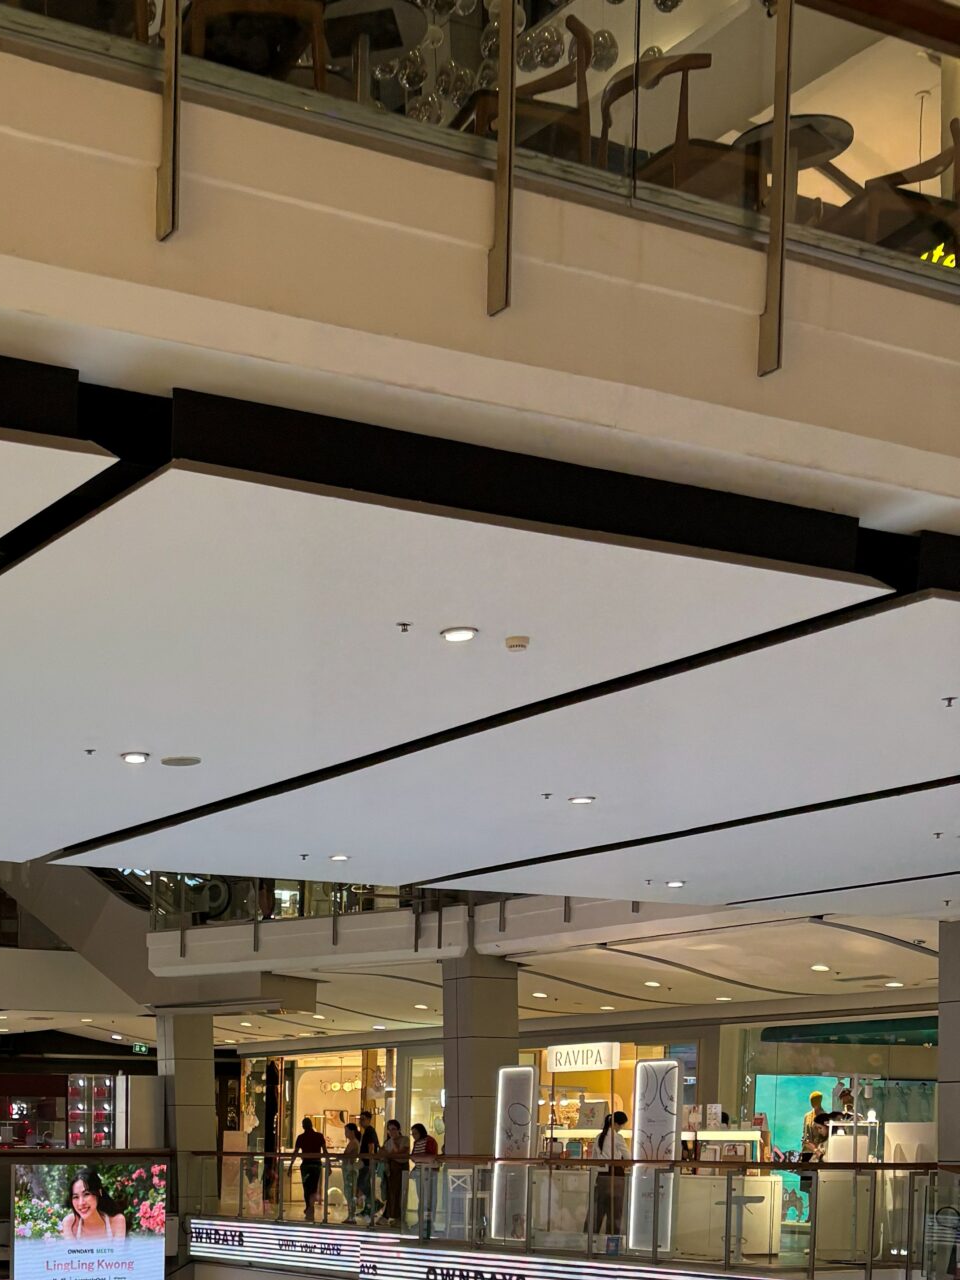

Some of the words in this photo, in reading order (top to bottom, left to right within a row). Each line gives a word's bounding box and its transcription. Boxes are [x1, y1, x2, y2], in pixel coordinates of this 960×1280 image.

[554, 1048, 603, 1068] RAVIPA
[45, 1260, 95, 1272] LingLing
[96, 1259, 134, 1272] Kwong
